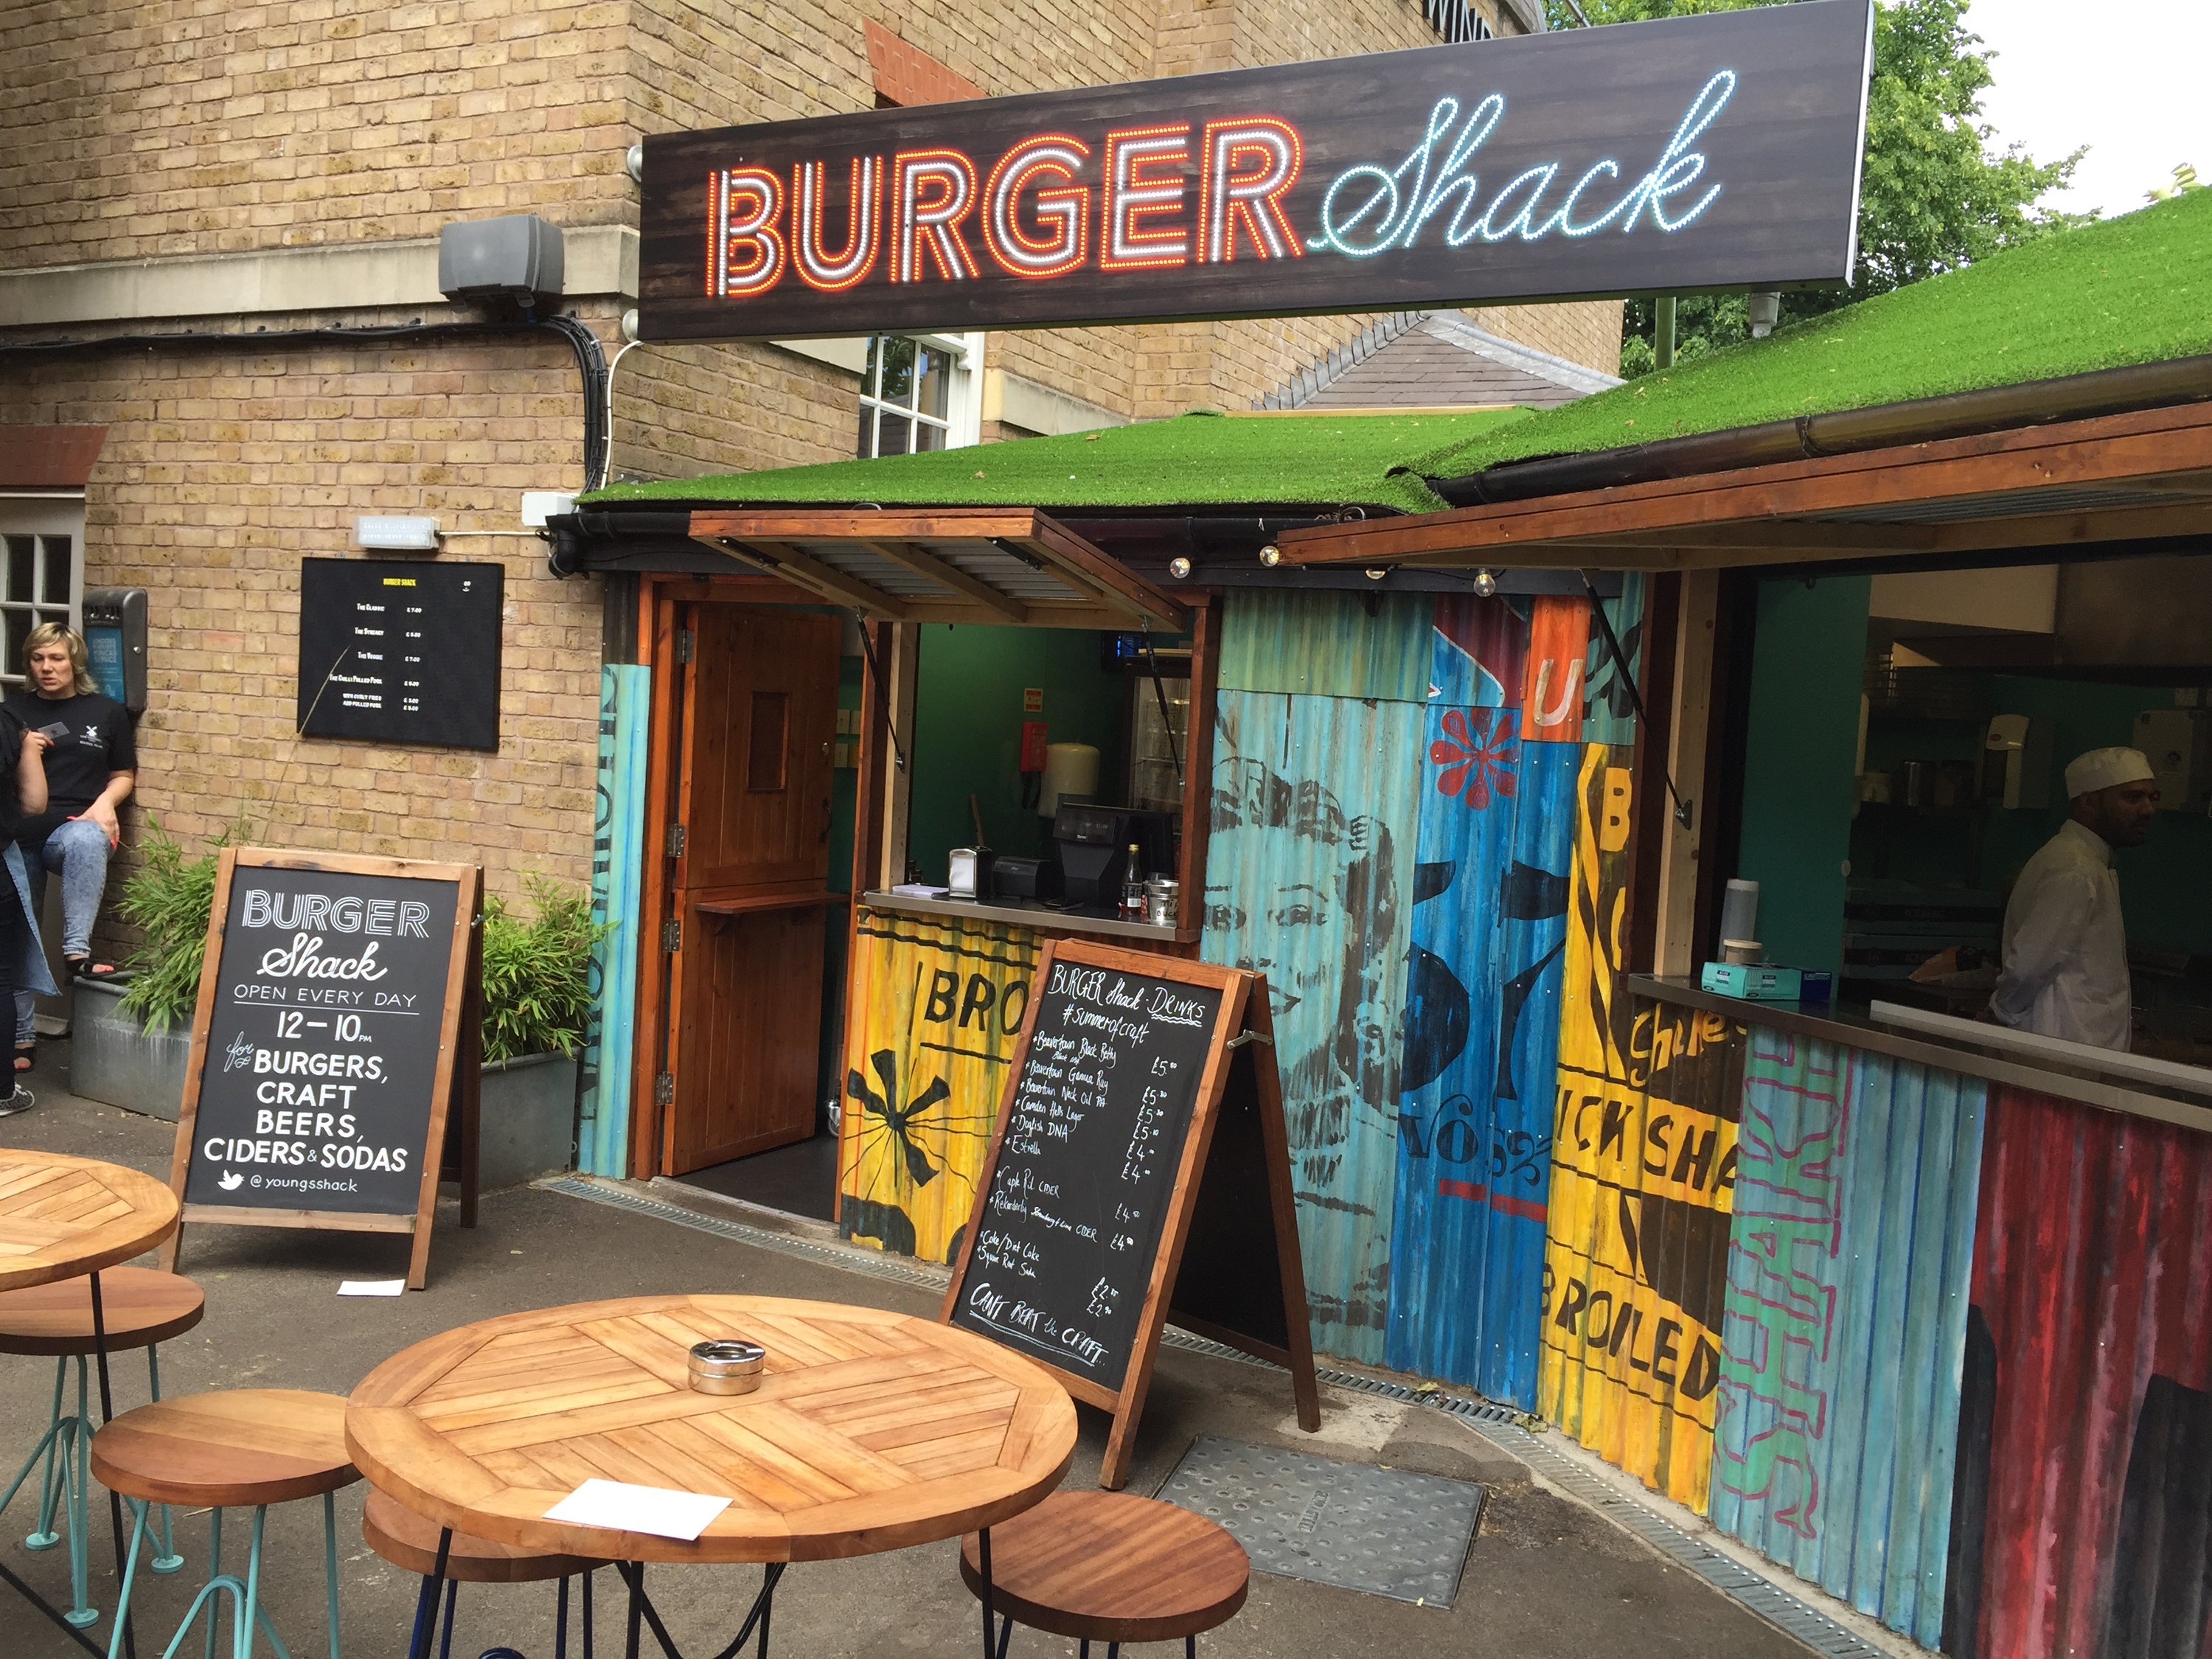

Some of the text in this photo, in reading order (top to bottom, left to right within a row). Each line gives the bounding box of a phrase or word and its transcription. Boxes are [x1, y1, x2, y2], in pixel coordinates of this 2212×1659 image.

[706, 68, 1737, 299] BURGER Shack
[383, 577, 417, 587] BURGER SHACK
[242, 889, 430, 939] BURGER
[256, 931, 388, 981] Shack
[233, 984, 417, 1009] OPEN EVERY DAY
[1047, 964, 1206, 1020] BURGER Shack DRINKS
[253, 1048, 389, 1083] BURGERS,
[256, 1080, 358, 1110] CRAFT
[1020, 1095, 1046, 1114] Camden
[255, 1110, 365, 1142] BEERS,
[1047, 1121, 1068, 1144] DNA
[1555, 1085, 1635, 1162] ICK
[1023, 1242, 1040, 1262] Coke
[1008, 1300, 1046, 1333] BEAT
